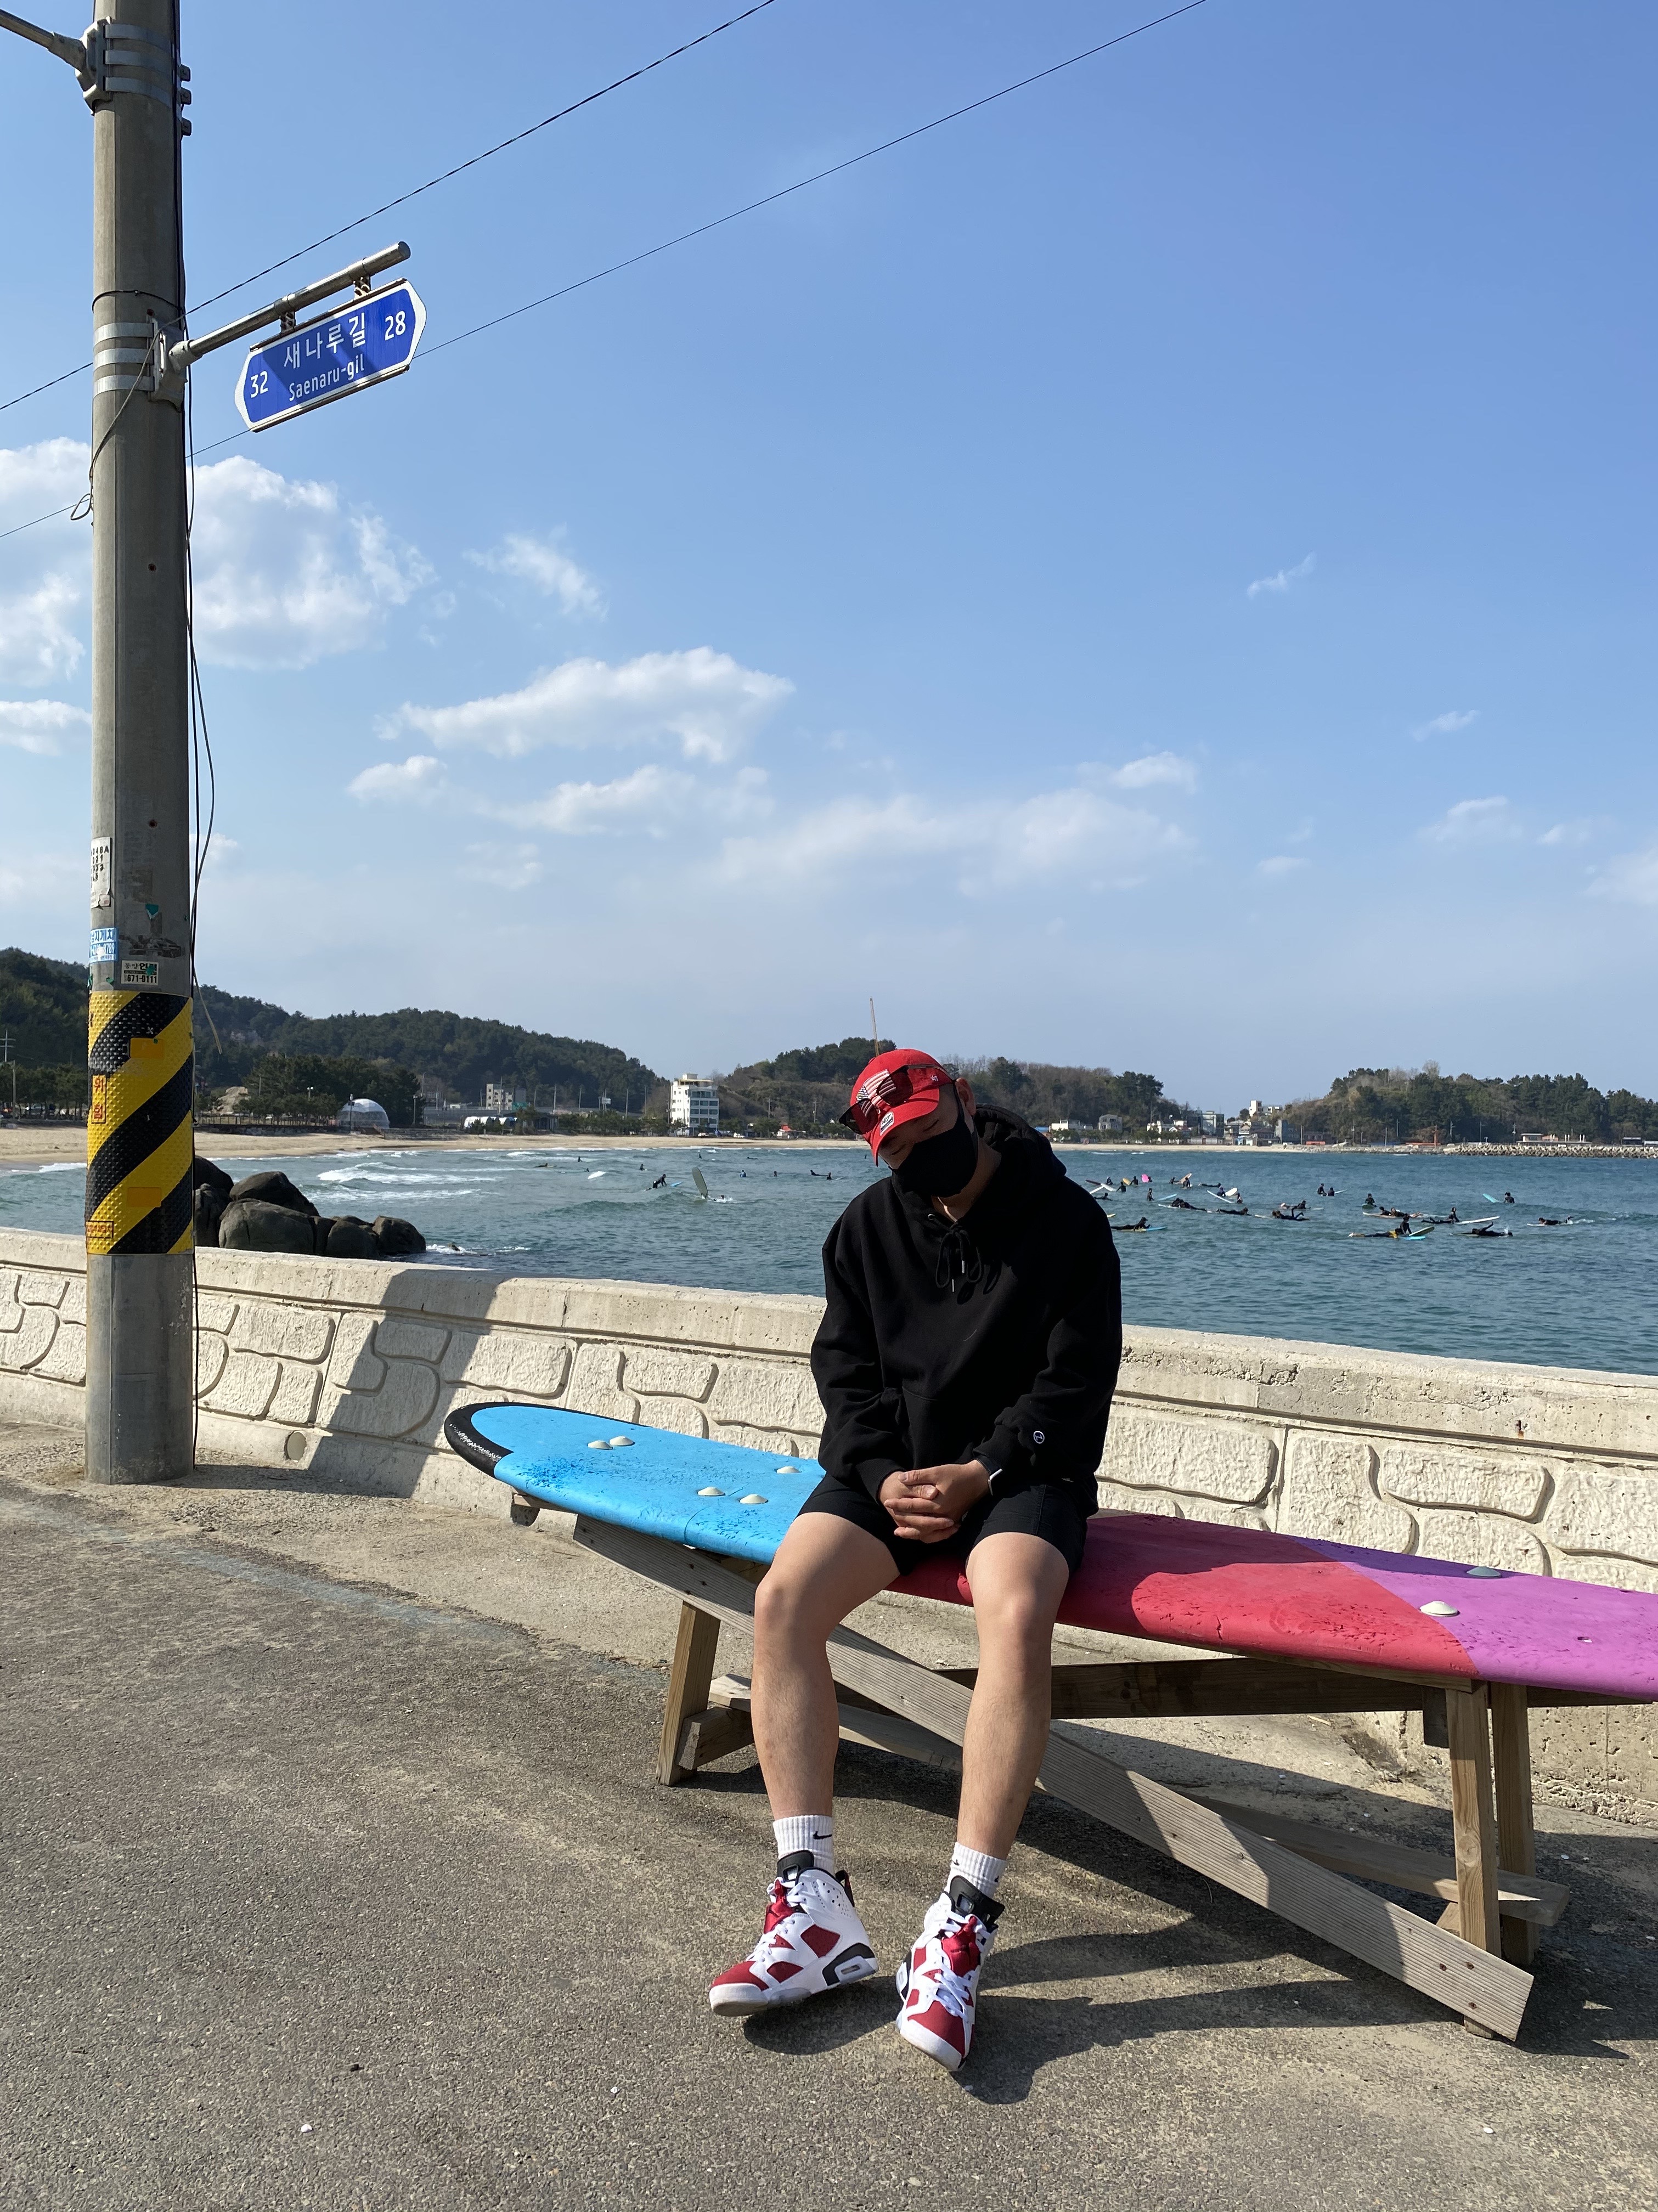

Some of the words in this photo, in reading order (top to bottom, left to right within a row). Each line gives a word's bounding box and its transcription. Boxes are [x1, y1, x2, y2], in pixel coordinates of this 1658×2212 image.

[284, 312, 366, 369] 새나루길
[385, 311, 406, 341] 28
[250, 370, 269, 398] 32
[289, 353, 364, 401] Saenaru-gil
[127, 974, 157, 983] 671-9111
[94, 1077, 104, 1119] 위험
